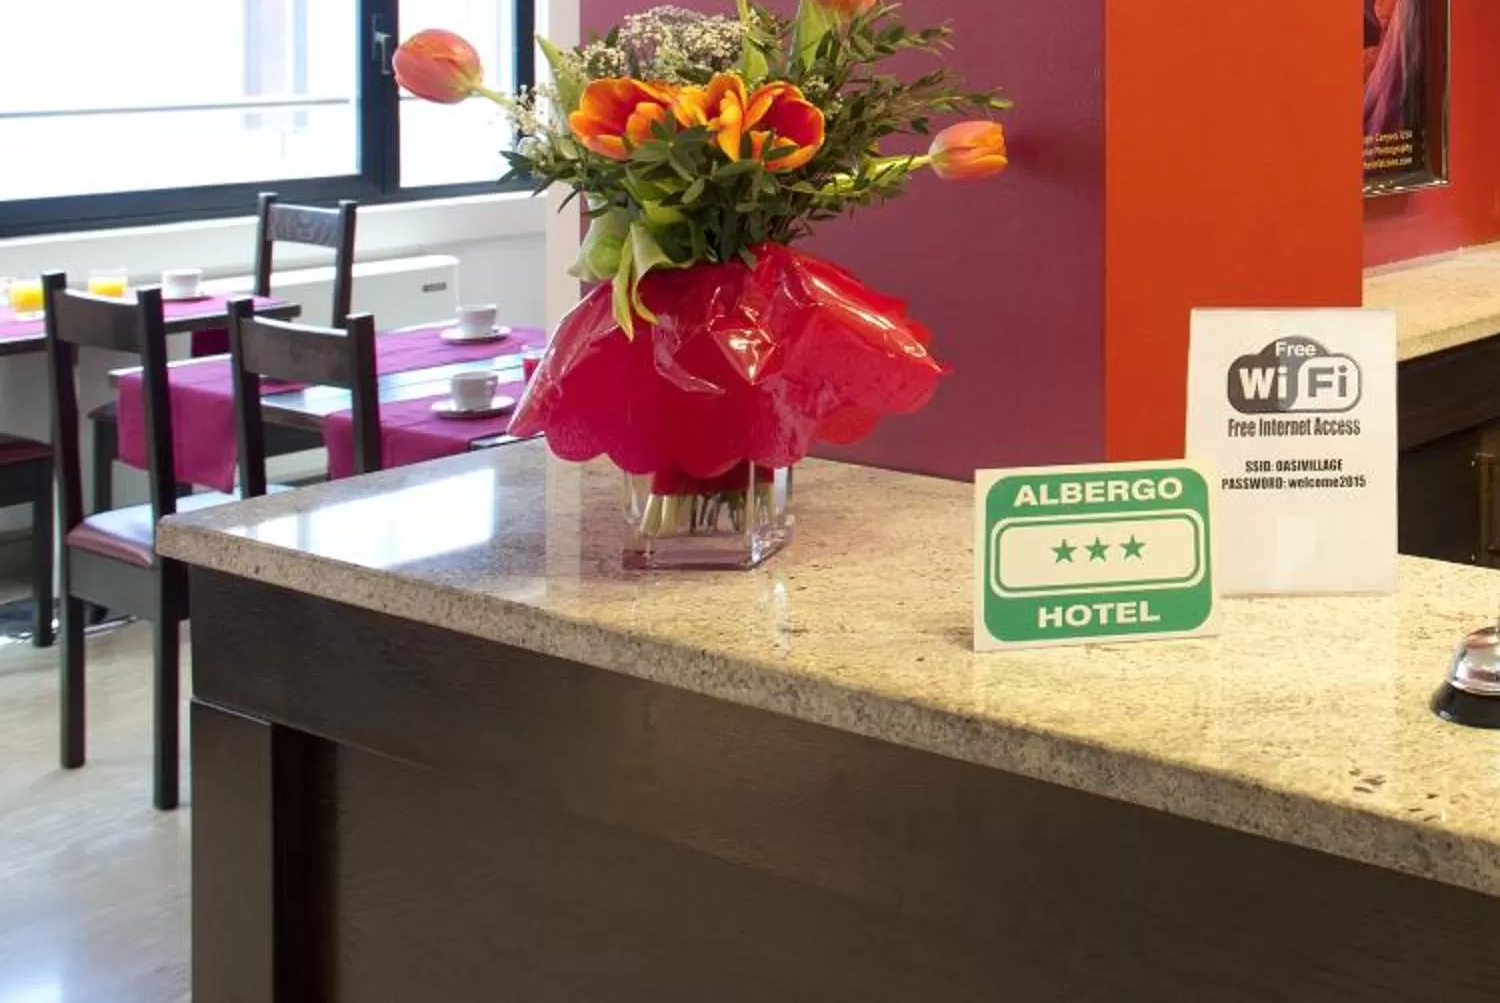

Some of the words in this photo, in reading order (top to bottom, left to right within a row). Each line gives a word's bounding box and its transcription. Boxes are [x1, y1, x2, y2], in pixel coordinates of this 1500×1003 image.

[1275, 341, 1317, 357] Free
[1228, 418, 1256, 437] Free
[1259, 417, 1311, 437] Internet
[1314, 417, 1361, 436] Access
[1275, 458, 1343, 472] OASIVILLAGE
[1288, 474, 1367, 489] welcome2015
[1013, 477, 1183, 508] ALBERGO
[1037, 600, 1161, 629] HOTEL
